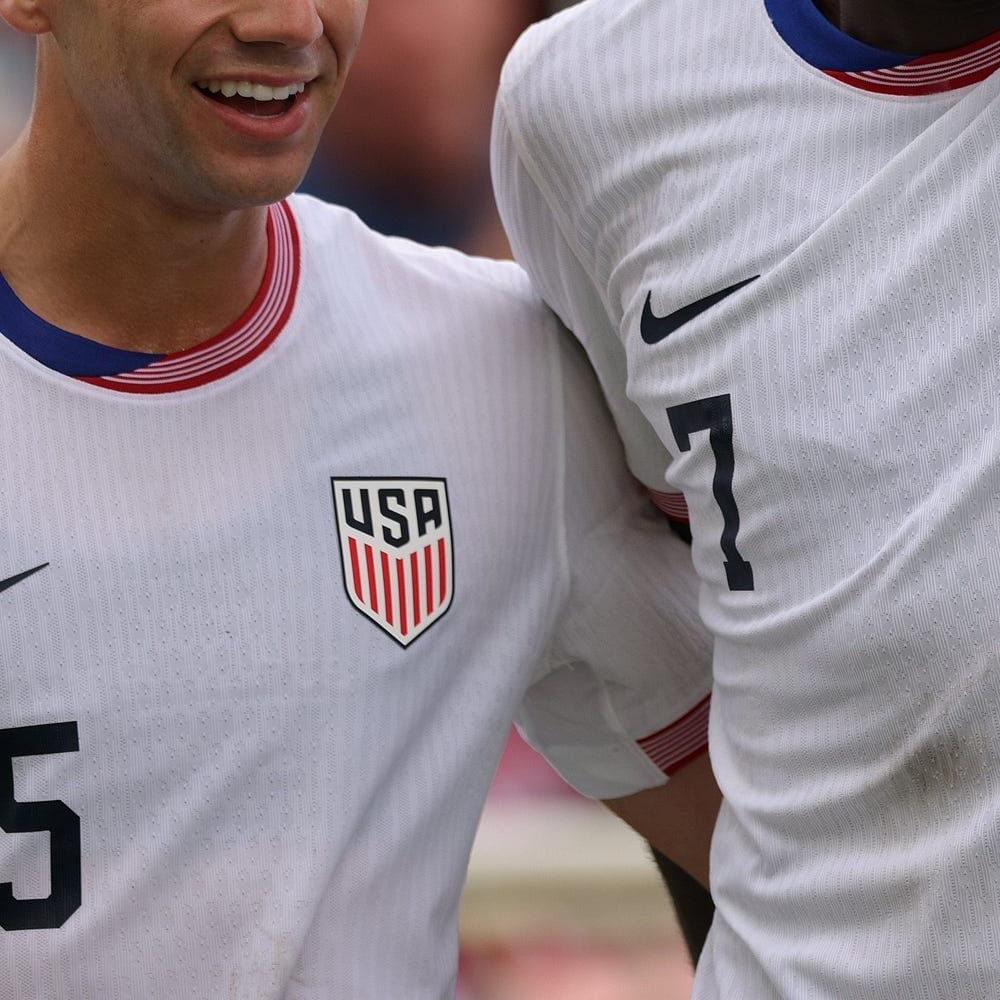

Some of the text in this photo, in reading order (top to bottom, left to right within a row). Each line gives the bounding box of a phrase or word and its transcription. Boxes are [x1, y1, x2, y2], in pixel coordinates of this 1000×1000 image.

[341, 488, 443, 548] USA
[666, 393, 755, 591] 7
[0, 720, 82, 931] 5
